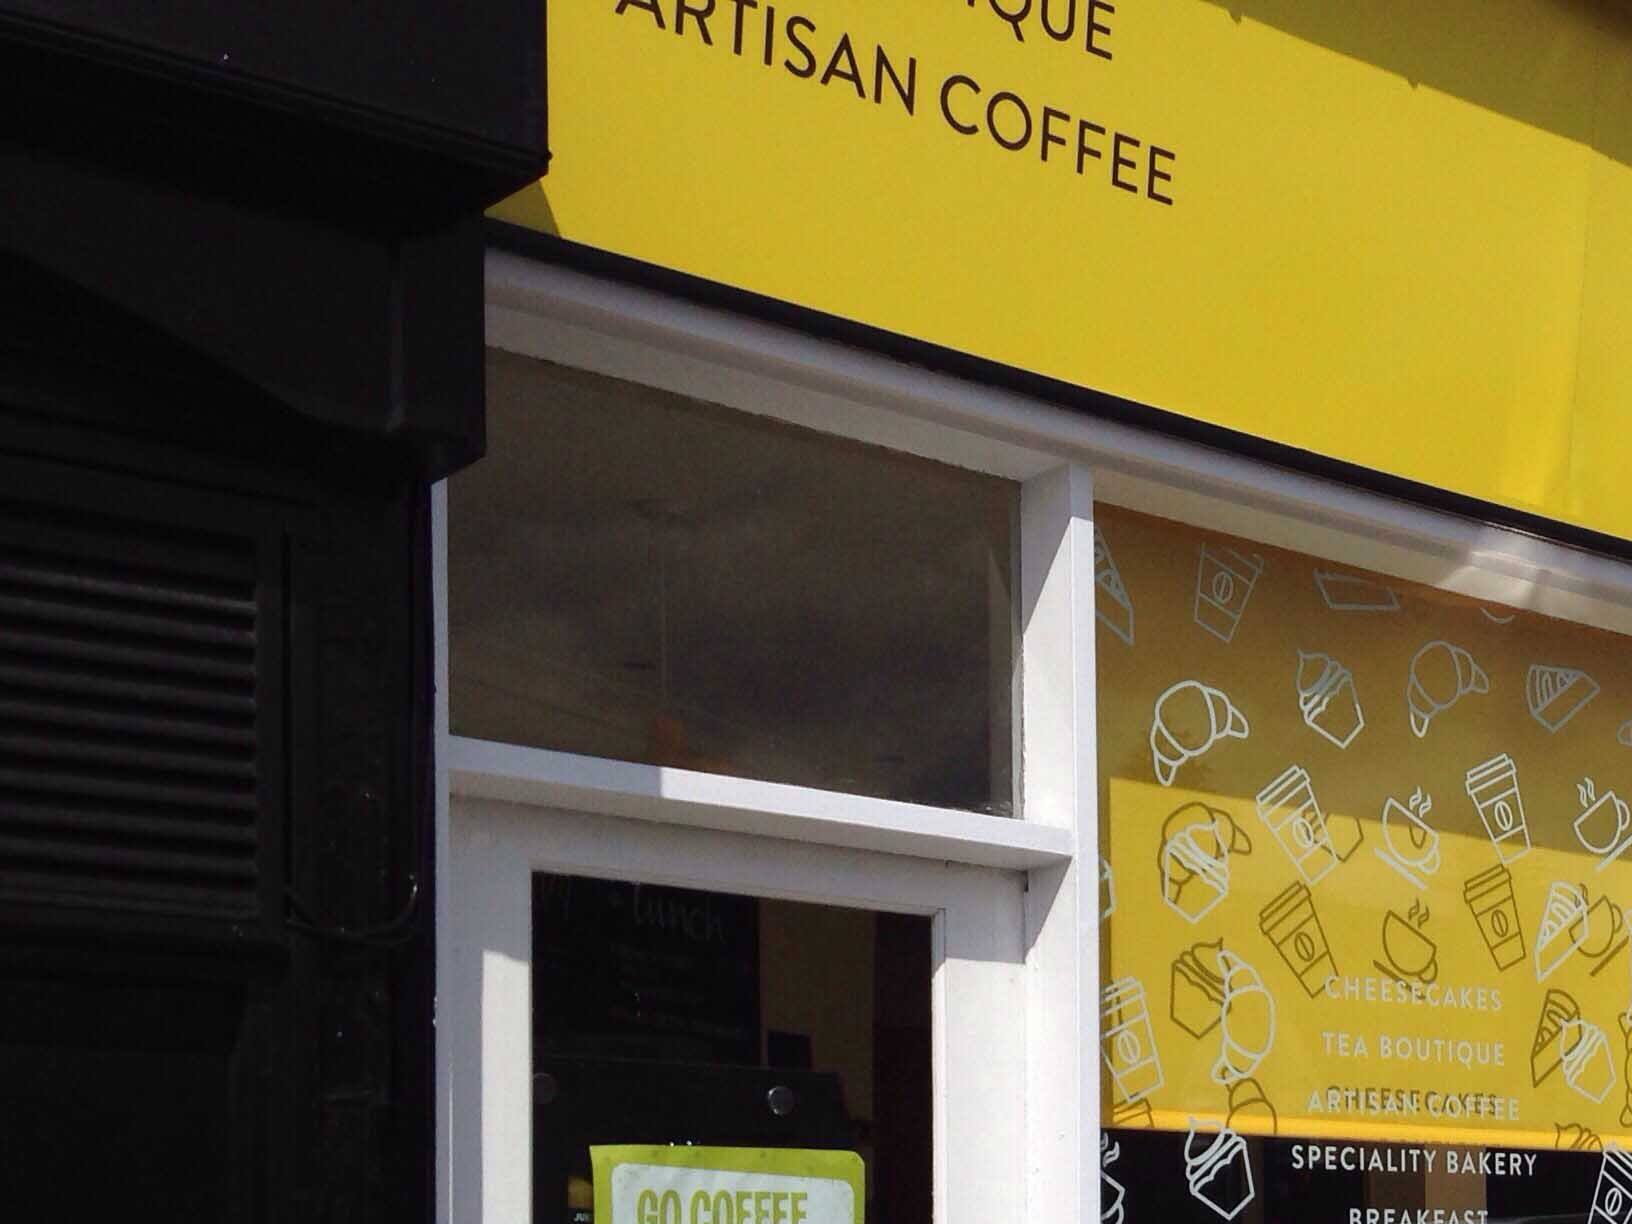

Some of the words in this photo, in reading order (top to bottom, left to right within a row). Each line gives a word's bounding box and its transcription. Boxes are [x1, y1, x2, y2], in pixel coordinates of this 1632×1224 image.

[940, 75, 1177, 206] COFFEE
[1324, 976, 1503, 1011] CHEESECAKES
[1322, 1032, 1369, 1057] TEA
[1380, 1035, 1505, 1069] BOUTIQUE
[1291, 1145, 1436, 1173] SPECIALITY
[1447, 1150, 1537, 1176] BAKERY
